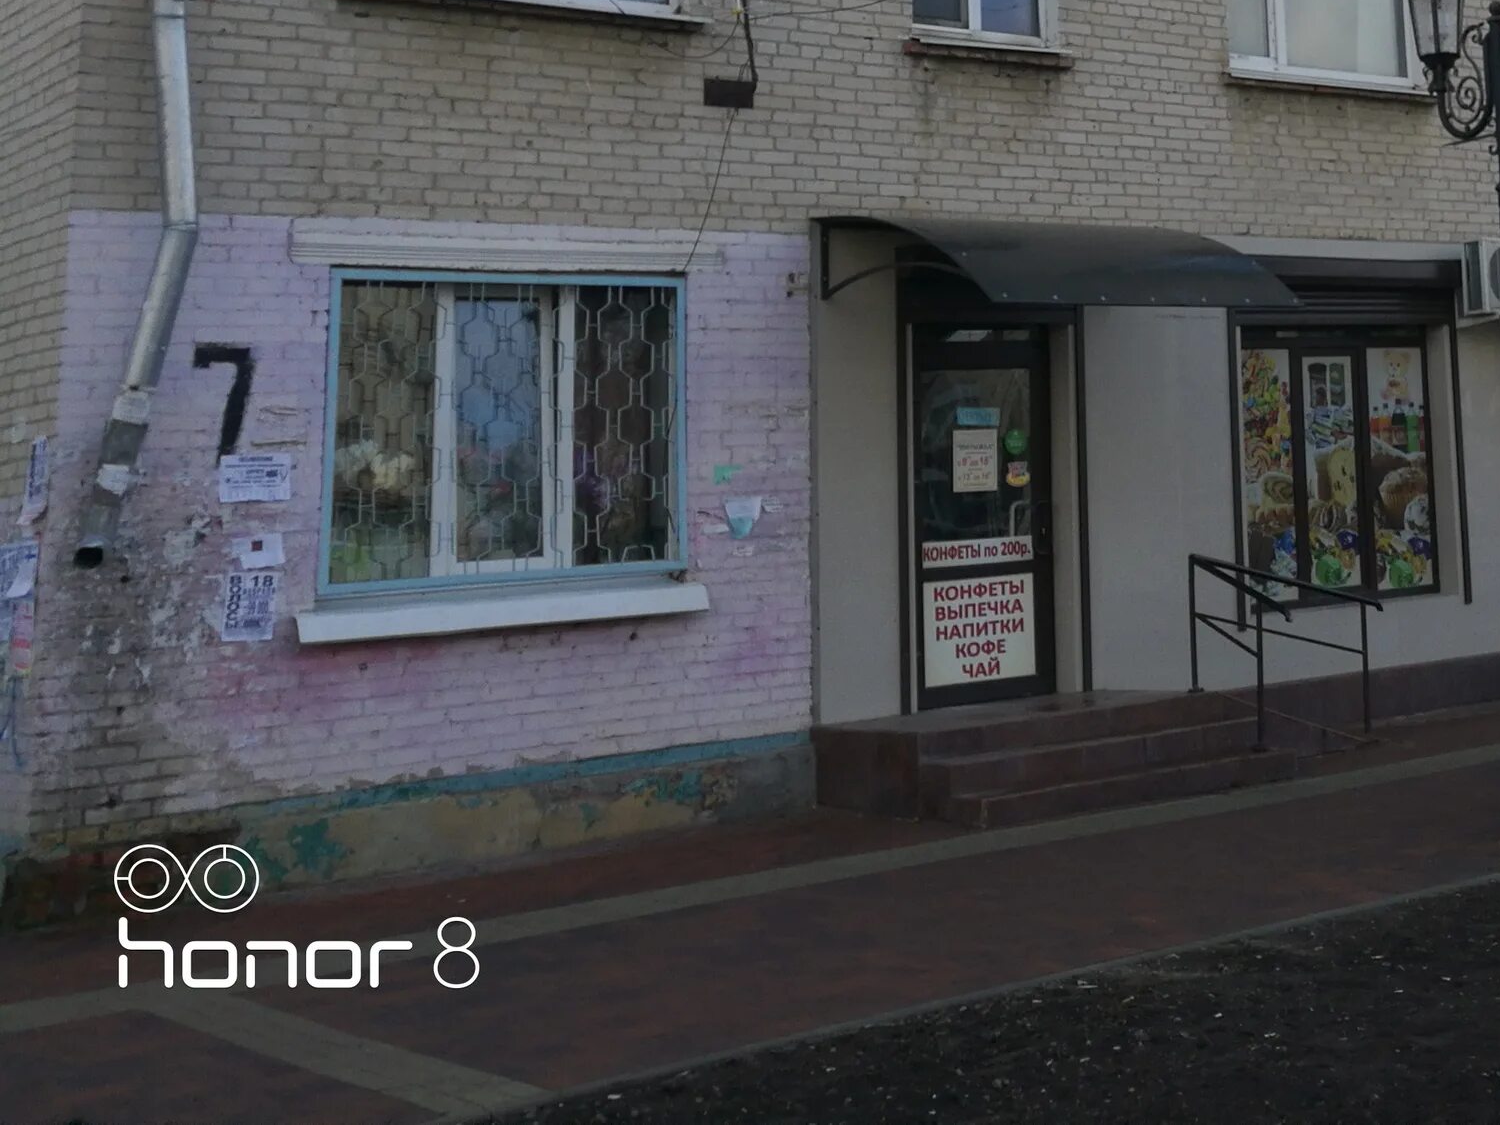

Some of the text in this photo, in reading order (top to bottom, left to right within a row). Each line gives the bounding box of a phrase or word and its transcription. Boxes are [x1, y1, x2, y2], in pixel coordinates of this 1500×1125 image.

[192, 342, 255, 469] 7
[923, 541, 1031, 562] КОНФЕТЫ по 200р.
[934, 579, 1025, 603] КОНФЕТЫ
[935, 598, 1024, 622] ВЫПЕЧКА
[936, 617, 1024, 641] НАПИТКИ
[956, 639, 1006, 659] КОФЕ
[962, 657, 1000, 678] ЧАЙ
